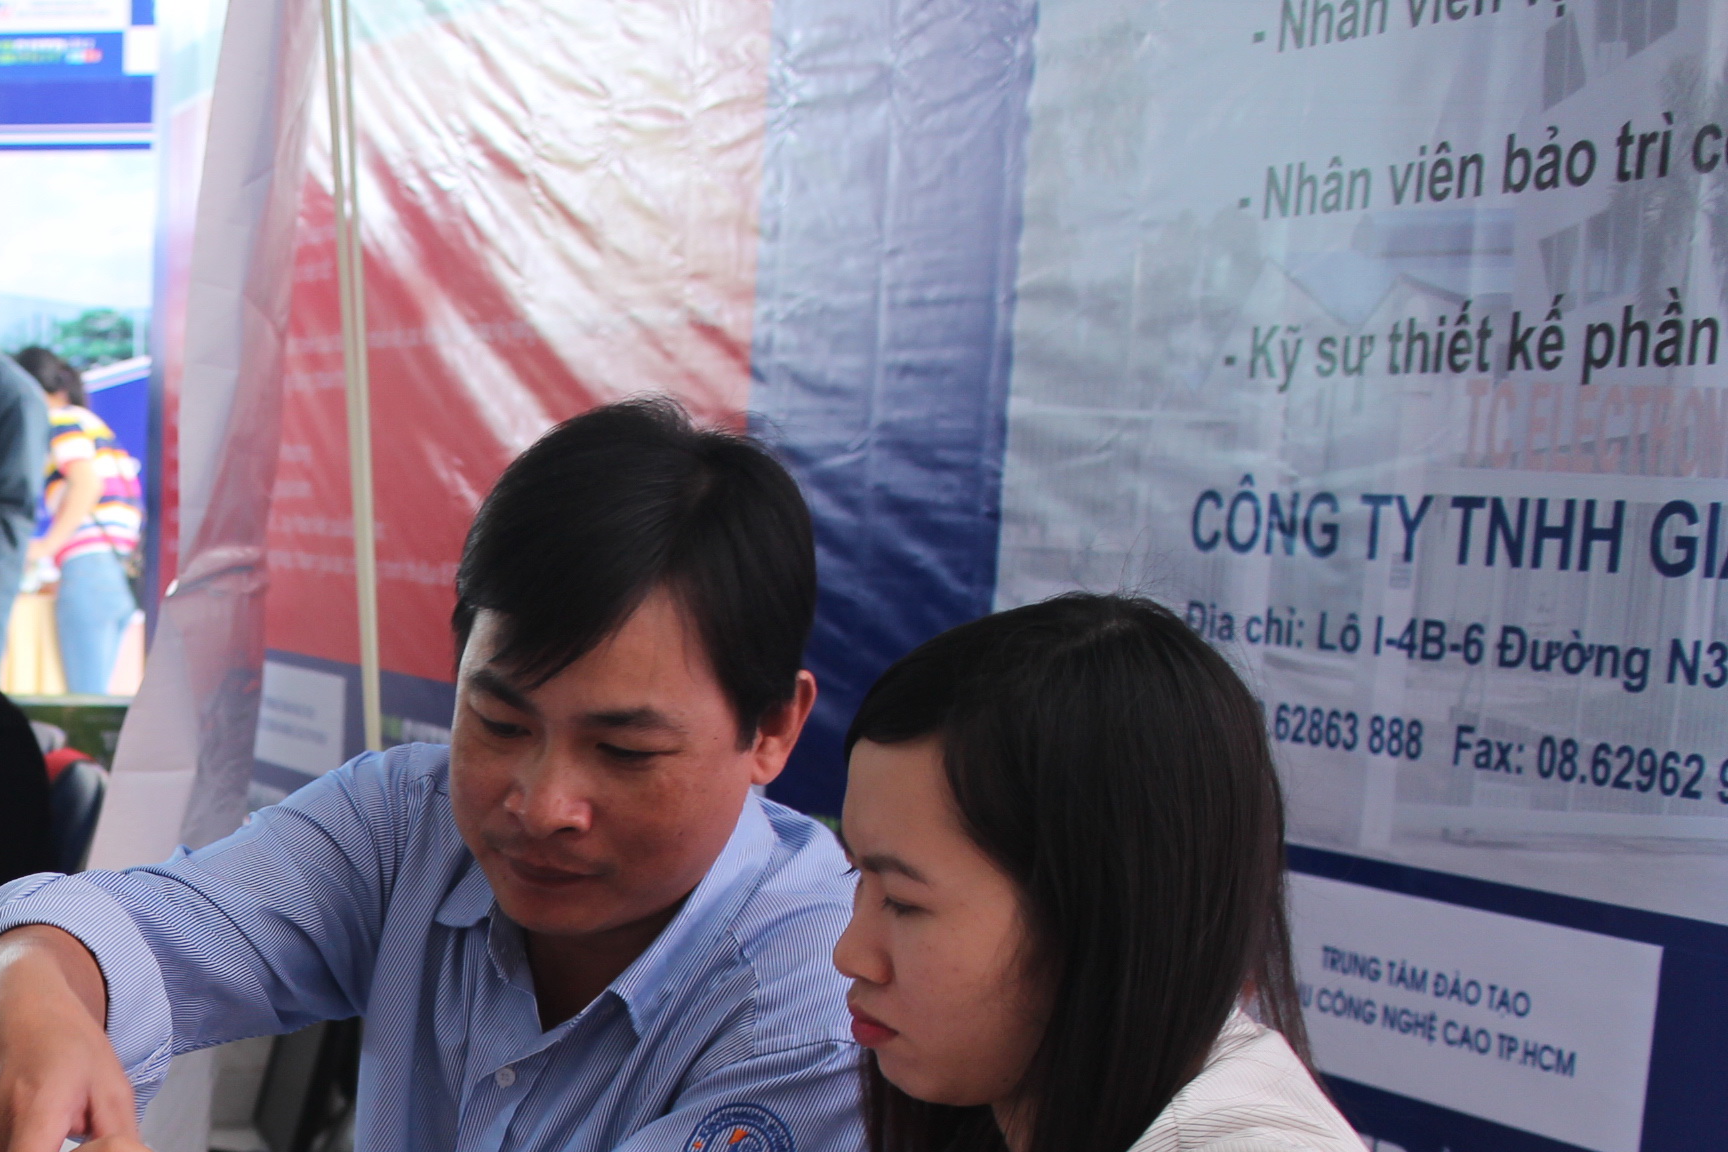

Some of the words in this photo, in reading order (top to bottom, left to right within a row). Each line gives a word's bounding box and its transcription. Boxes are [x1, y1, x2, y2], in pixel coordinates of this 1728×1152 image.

[1389, 141, 1484, 205] viên
[1501, 125, 1598, 195] bảo
[1615, 111, 1675, 184] trì
[1314, 333, 1375, 379] sư
[1387, 300, 1492, 376] thiết
[1506, 293, 1567, 372] kế
[1582, 287, 1719, 385] phần
[1191, 474, 1341, 558] CÔNG
[1360, 494, 1434, 562] TY
[1450, 495, 1627, 574] TNHH
[1318, 609, 1362, 655] Lô
[1497, 625, 1652, 694] Đường
[1274, 703, 1359, 751] 62863
[1369, 716, 1424, 761] 888
[1453, 724, 1525, 775] Fax:
[1537, 735, 1704, 801] 08.62962
[1322, 945, 1382, 983] TRUNG
[1387, 958, 1429, 993] TÂM
[1433, 968, 1482, 1006] ĐÀO
[1487, 983, 1531, 1018] TẠO
[1317, 986, 1377, 1025] CÔNG
[1382, 1004, 1438, 1045] NGHỆ
[1443, 1020, 1492, 1055] CAO
[1497, 1032, 1577, 1078] TP.HCM
